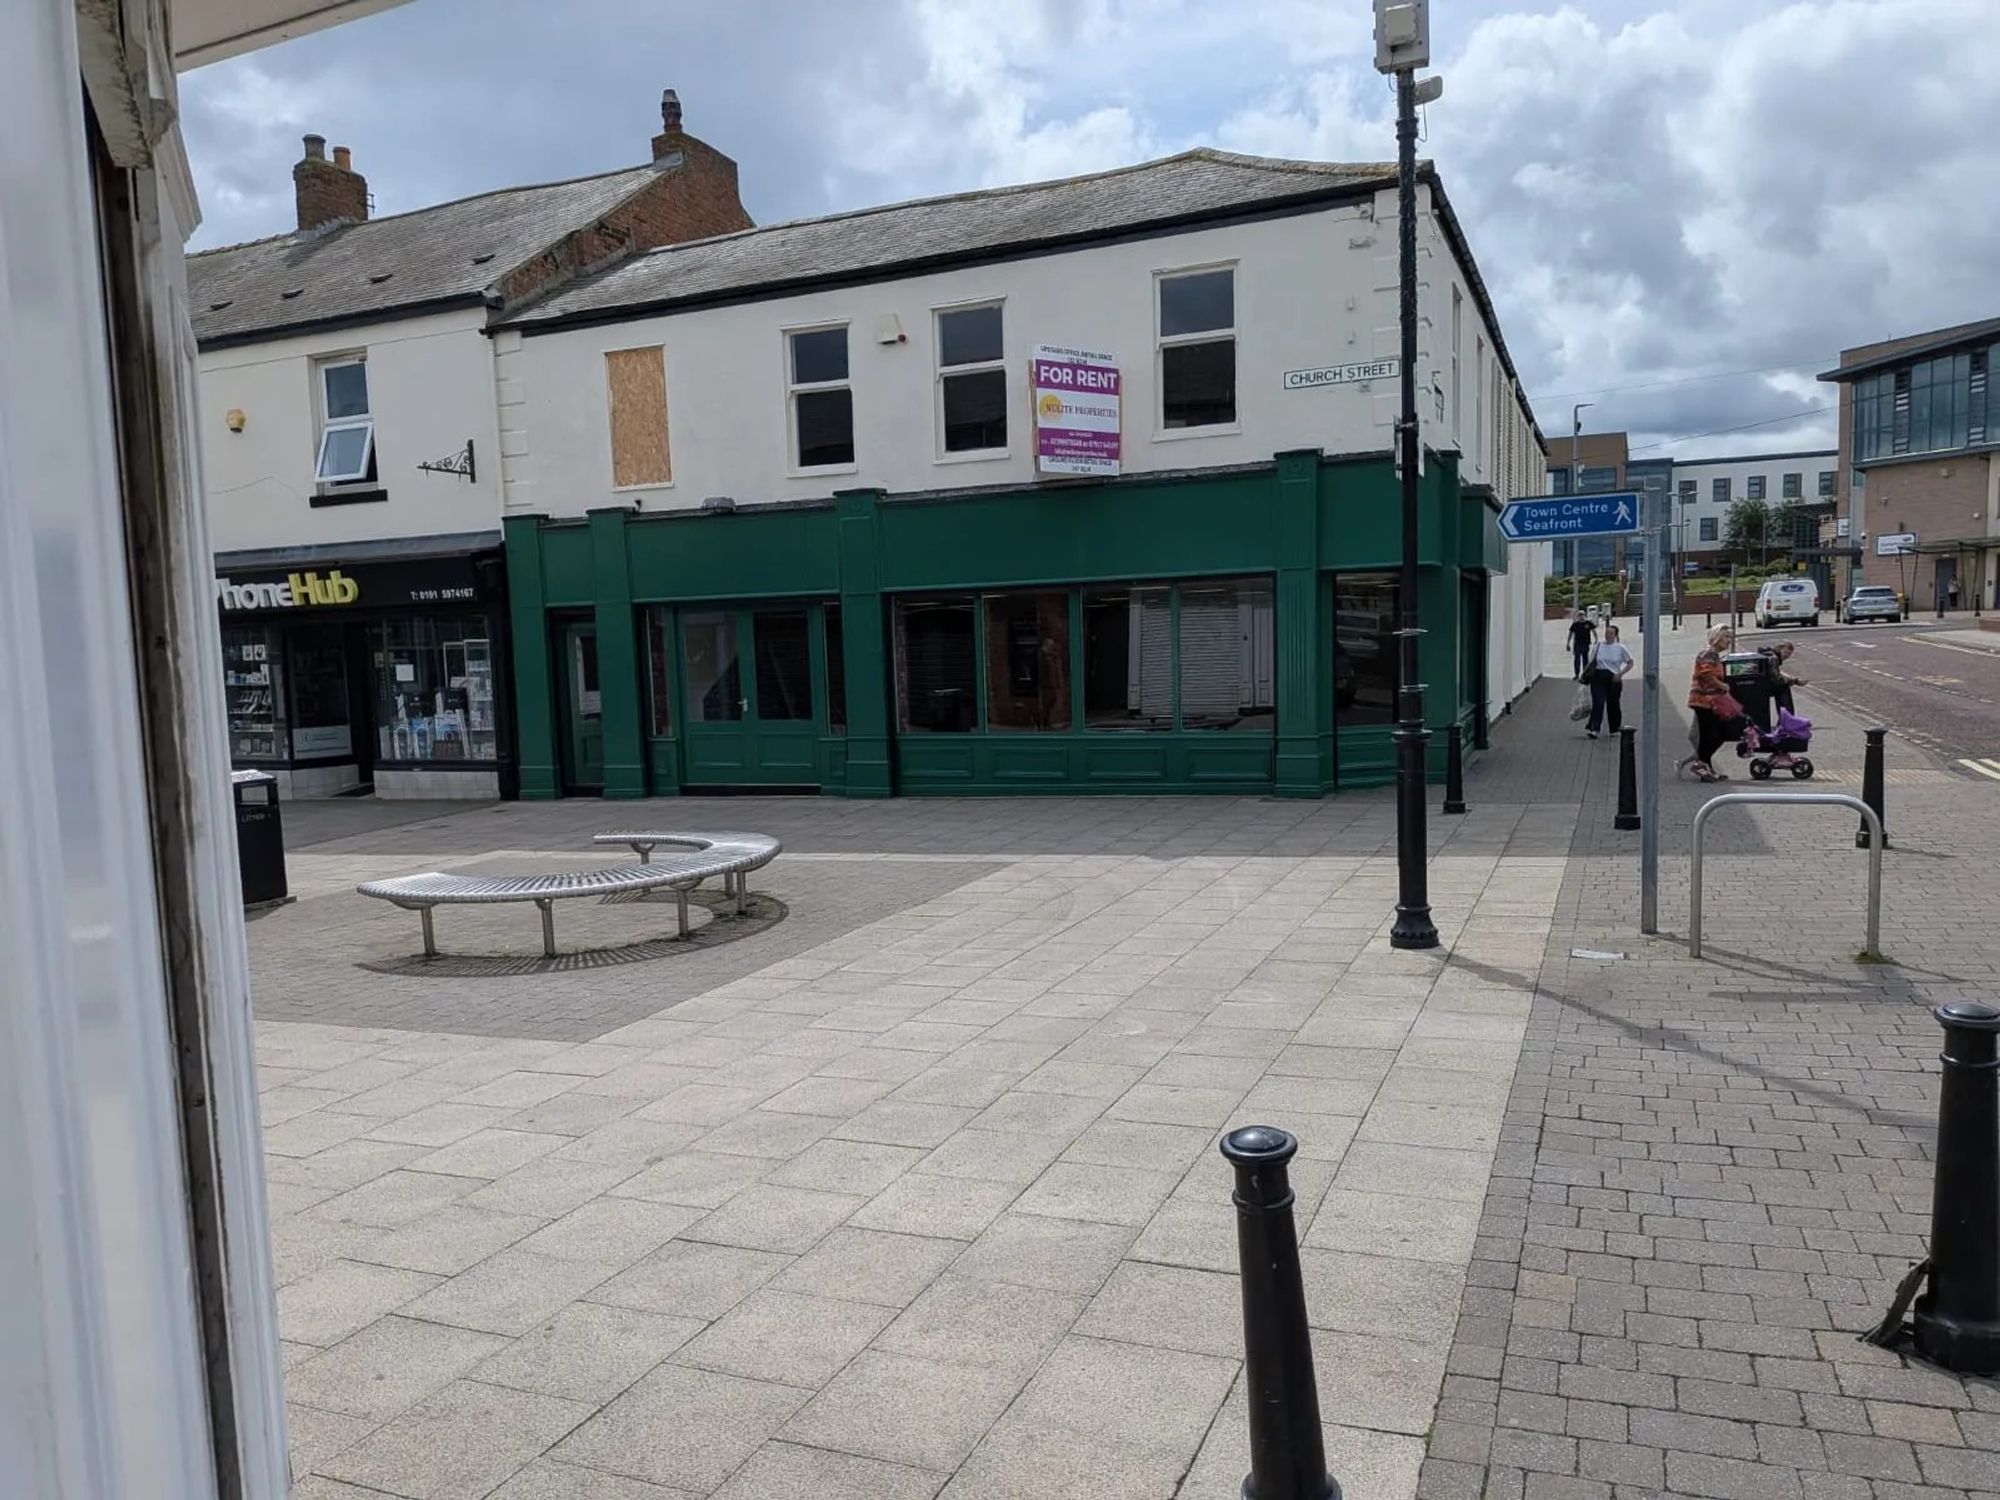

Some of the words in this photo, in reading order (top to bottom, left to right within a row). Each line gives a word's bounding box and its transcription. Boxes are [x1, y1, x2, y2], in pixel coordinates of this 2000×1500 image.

[1040, 364, 1073, 385] FOR
[1076, 369, 1118, 389] RENT
[1290, 369, 1342, 385] CHURCH
[1347, 362, 1394, 379] STREET
[1523, 506, 1558, 519] Town
[1562, 503, 1608, 516] Centre
[1523, 518, 1583, 532] Seafront
